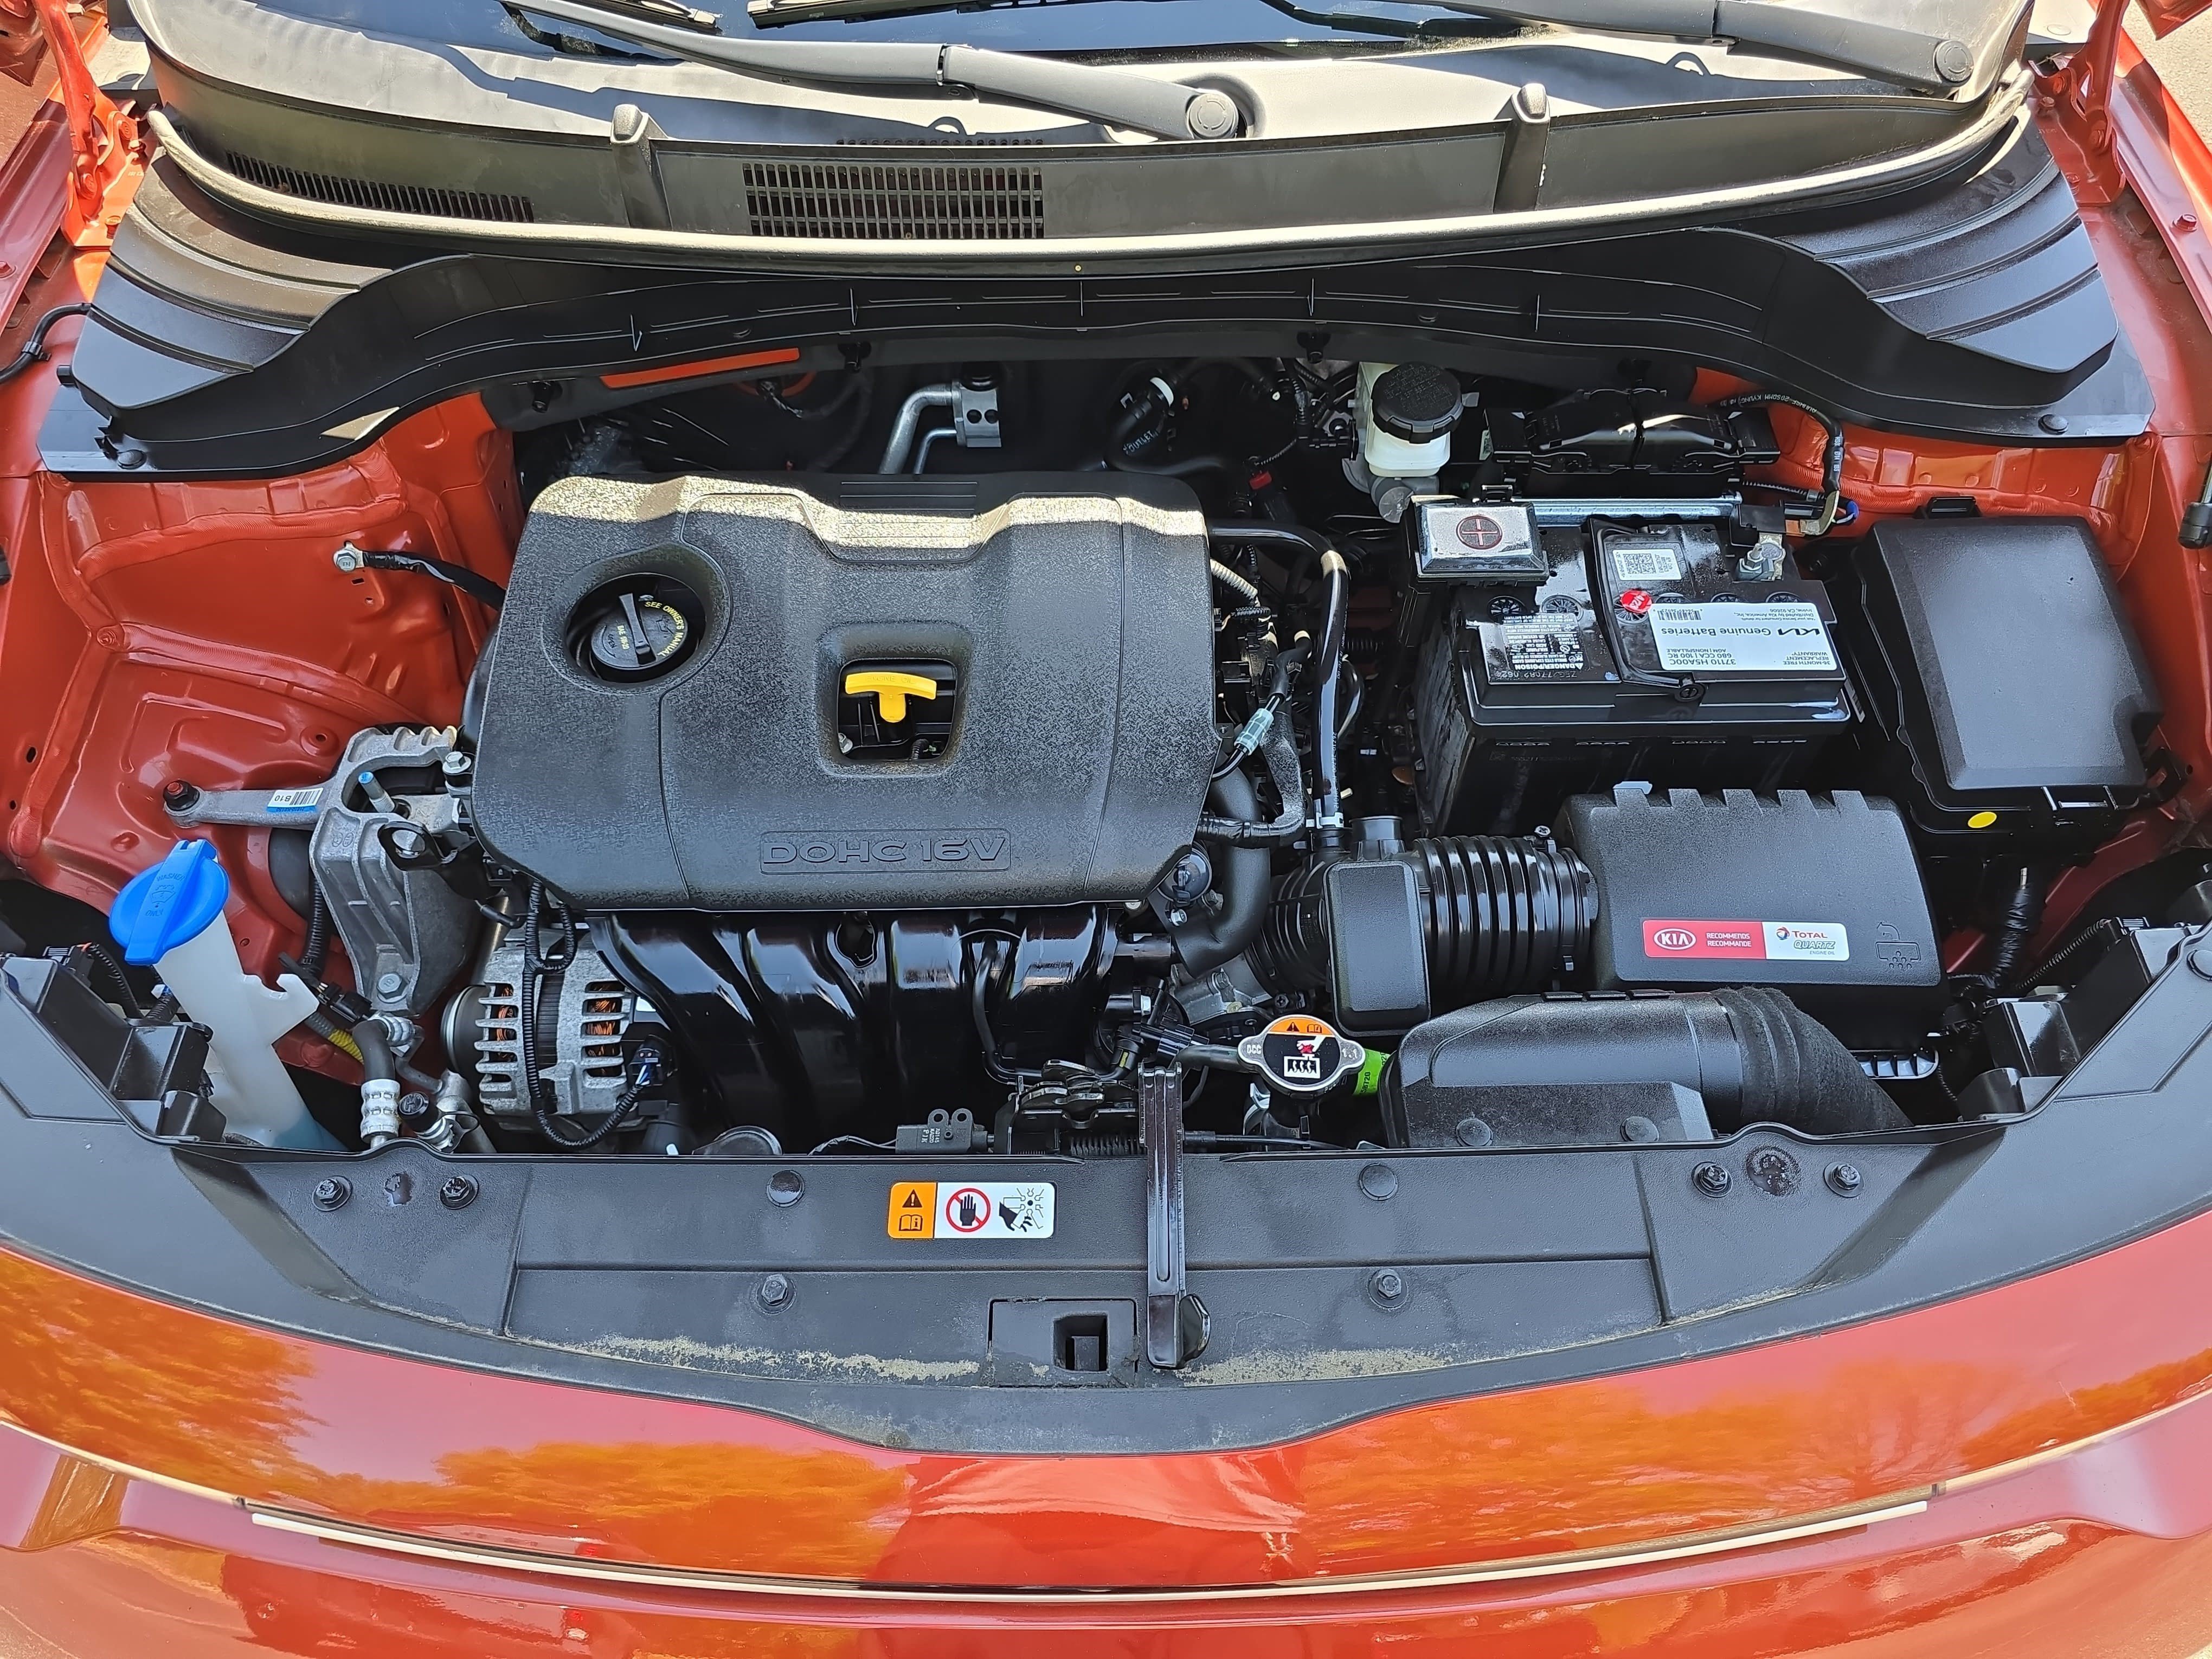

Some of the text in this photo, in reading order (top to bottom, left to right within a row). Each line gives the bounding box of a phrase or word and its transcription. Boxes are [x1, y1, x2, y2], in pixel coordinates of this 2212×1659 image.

[663, 605, 685, 630] OWNER'S
[617, 625, 626, 635] SAE
[1661, 627, 1716, 636] Batteries
[1720, 628, 1771, 636] Genuine
[657, 632, 684, 657] MANUAL
[902, 676, 916, 684] OIL
[762, 838, 1007, 864] DOHC 16V
[156, 872, 185, 883] WASHER
[144, 908, 164, 917] ONLY
[1791, 930, 1828, 939] TOTAL
[1661, 933, 1689, 947] KIA
[1707, 940, 1752, 948] RECOMMANDE
[1793, 941, 1836, 950] QUARTZ
